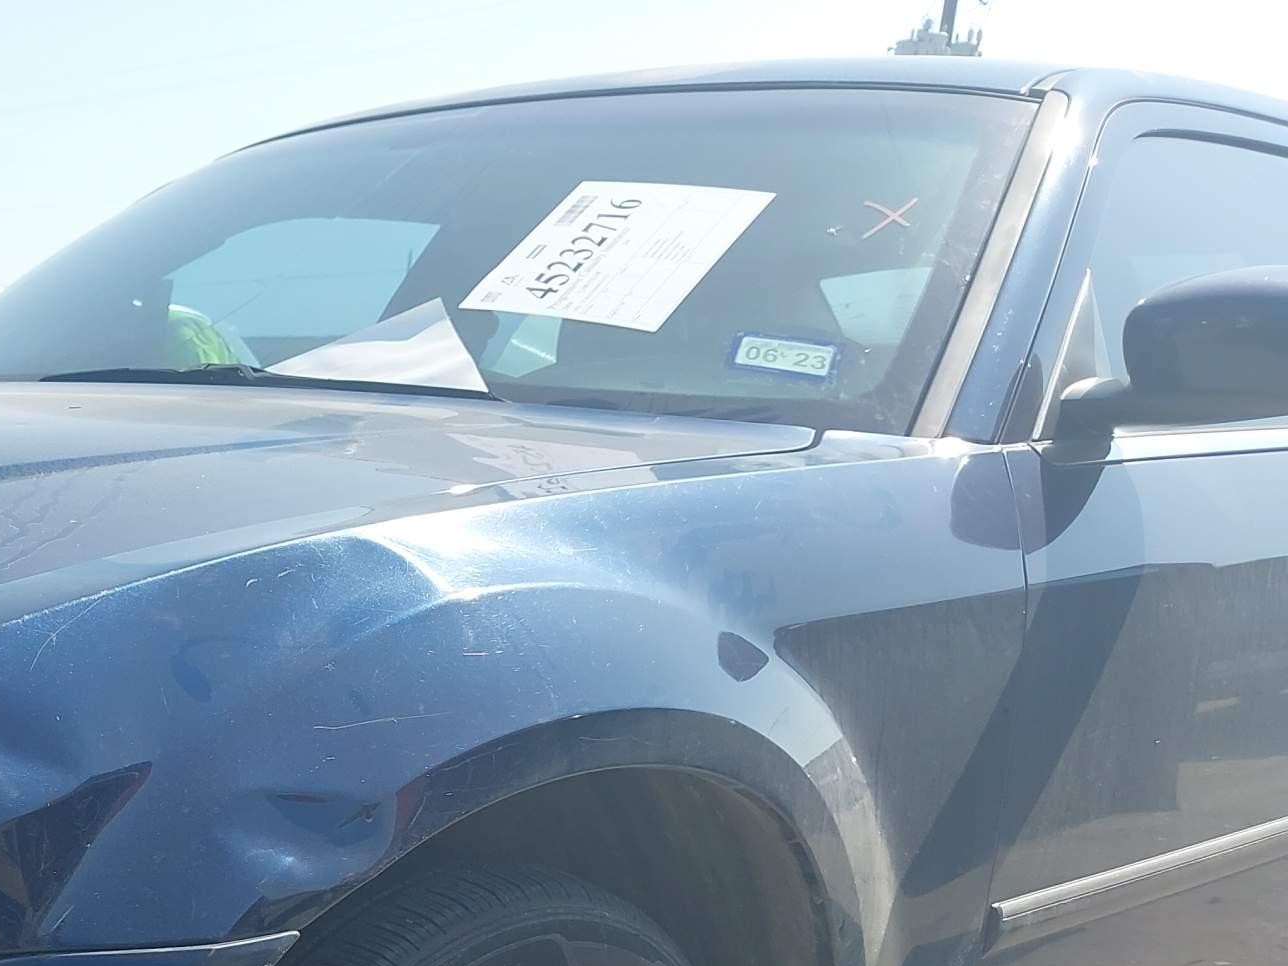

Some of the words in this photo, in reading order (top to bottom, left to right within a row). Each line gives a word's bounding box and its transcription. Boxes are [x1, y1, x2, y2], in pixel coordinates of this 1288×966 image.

[523, 197, 643, 301] 45232716
[744, 345, 779, 363] 06
[791, 352, 827, 370] 23
